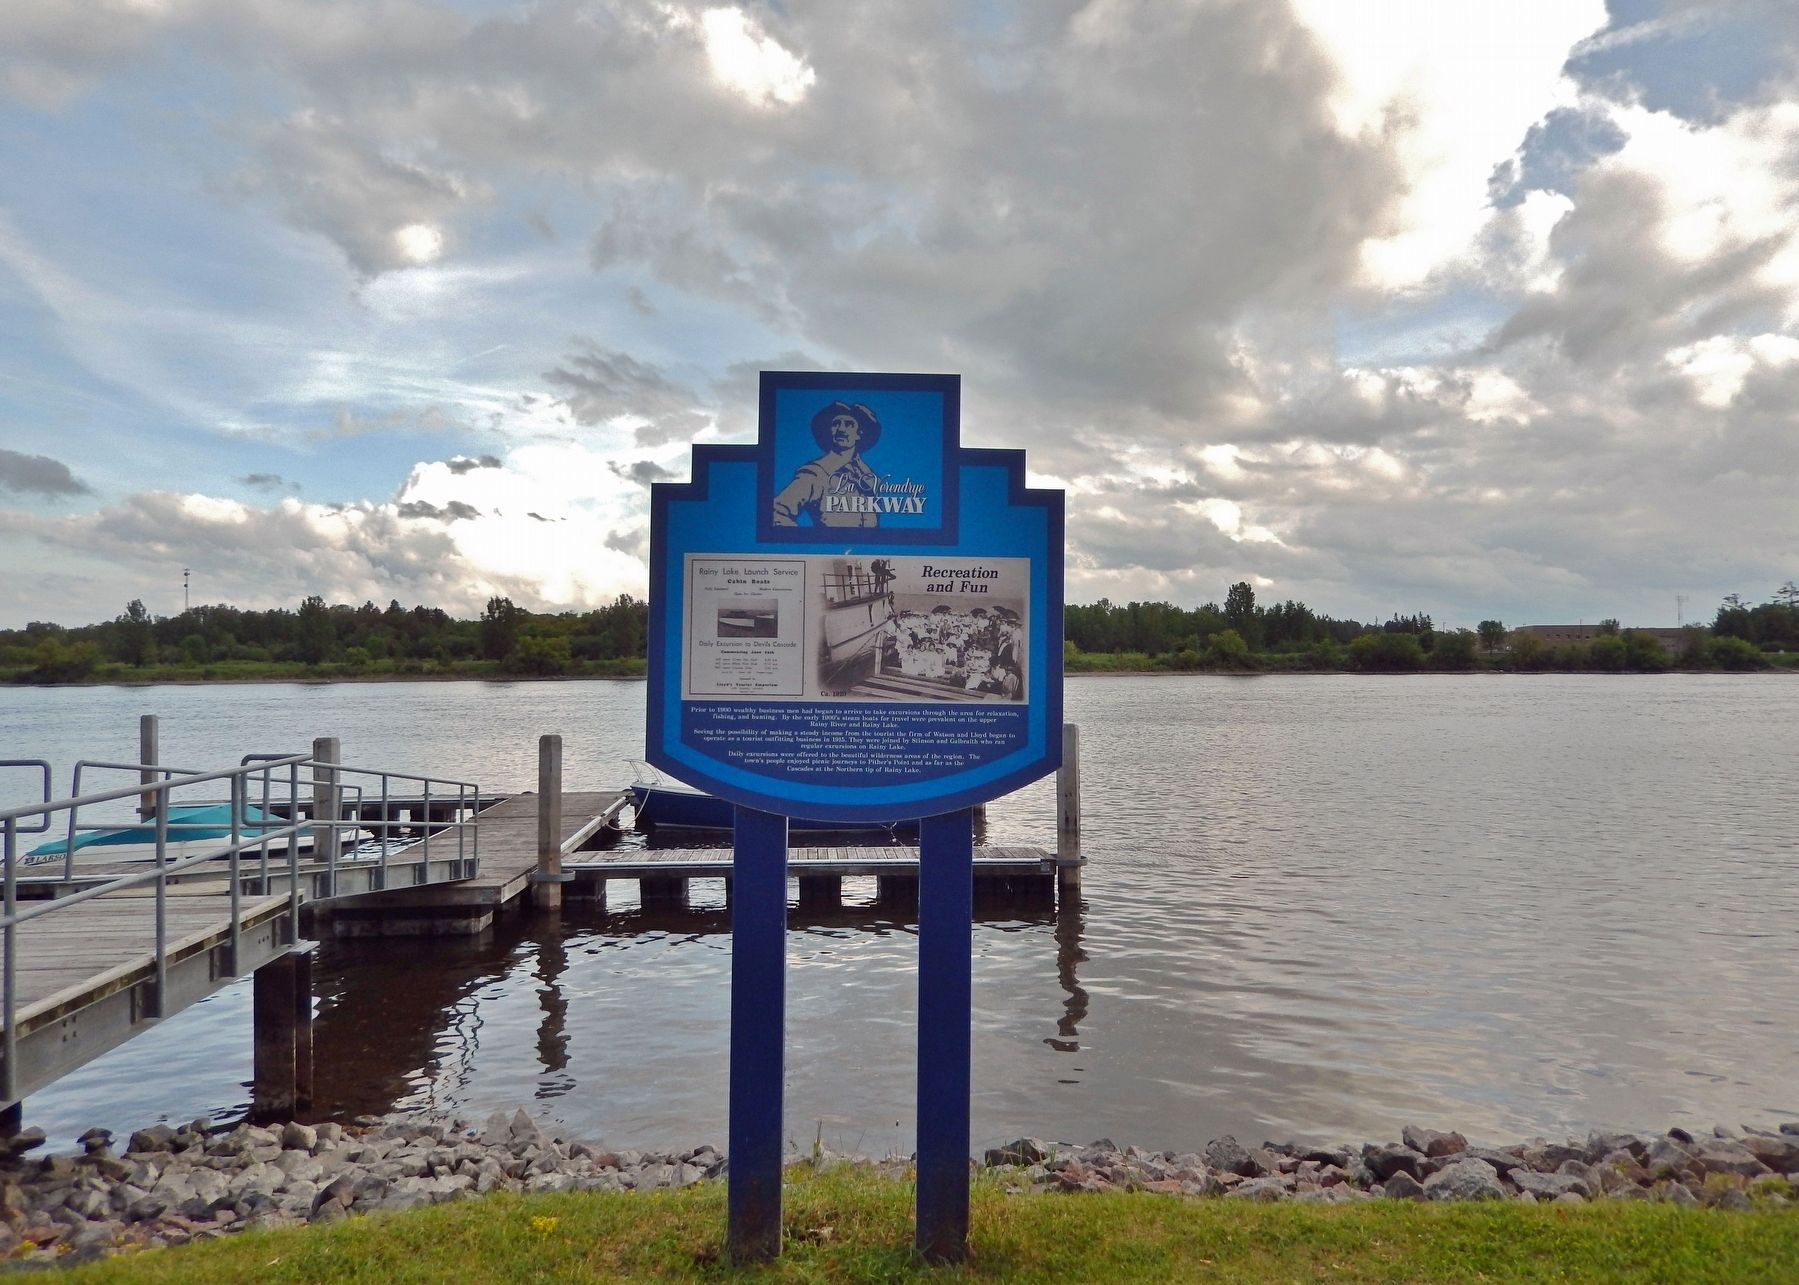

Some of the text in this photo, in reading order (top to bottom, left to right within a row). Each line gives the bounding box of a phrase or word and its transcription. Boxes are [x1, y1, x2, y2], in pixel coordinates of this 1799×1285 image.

[829, 472, 924, 498] La Verendrye
[825, 496, 928, 514] PARKWAY
[699, 568, 718, 576] Rainy
[921, 566, 999, 579] Recreation
[927, 581, 988, 593] and Fun
[36, 854, 68, 862] LARSO
